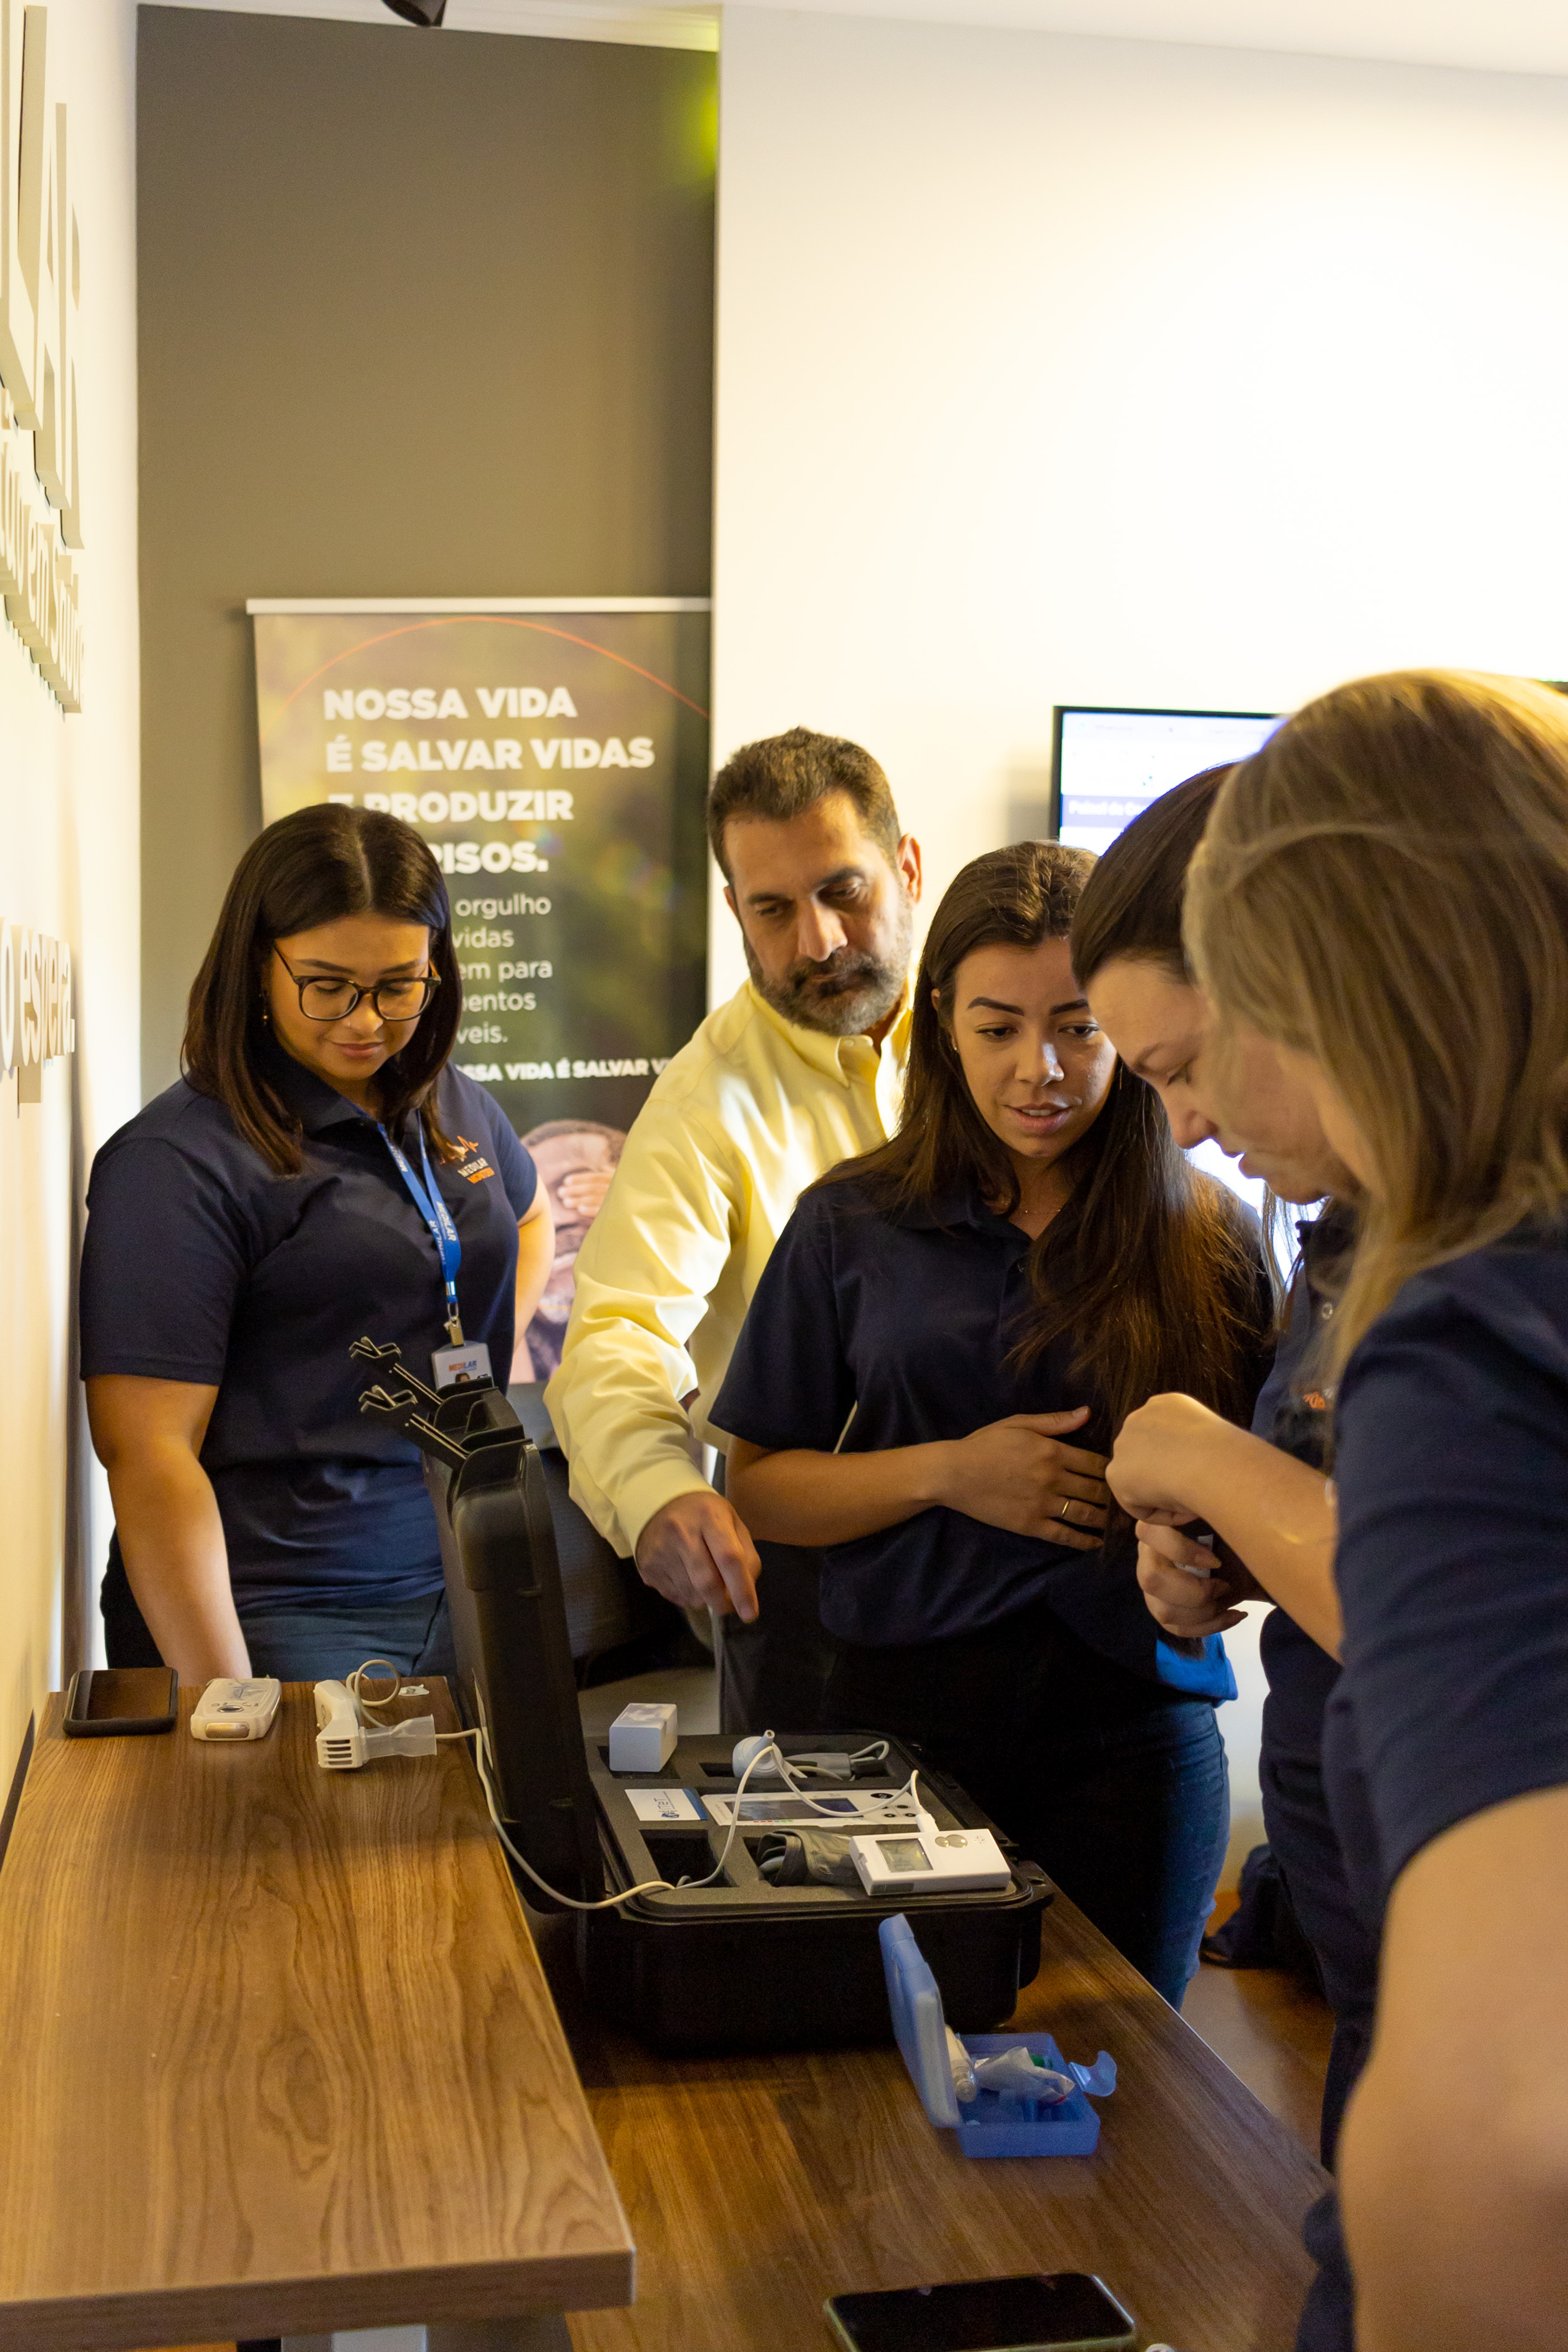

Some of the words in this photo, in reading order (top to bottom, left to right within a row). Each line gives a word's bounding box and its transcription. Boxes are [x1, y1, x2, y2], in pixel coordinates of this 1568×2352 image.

[0, 0, 85, 549] LAR
[27, 506, 49, 647] em
[51, 525, 85, 713] Saúde
[323, 688, 469, 720] NOSSA
[476, 686, 578, 718] VIDA
[326, 734, 353, 773] É
[361, 739, 523, 771] SALVAR
[530, 736, 656, 769] VIDAS
[455, 893, 552, 920] orgulho
[452, 926, 515, 948] vidas
[498, 960, 553, 983] para
[20, 927, 75, 1103] espera.
[455, 1063, 503, 1081] SSA
[504, 1061, 554, 1081] VIDA
[555, 1057, 571, 1078] É
[572, 1058, 649, 1078] SALVAR
[436, 1201, 457, 1241] MEDILAR
